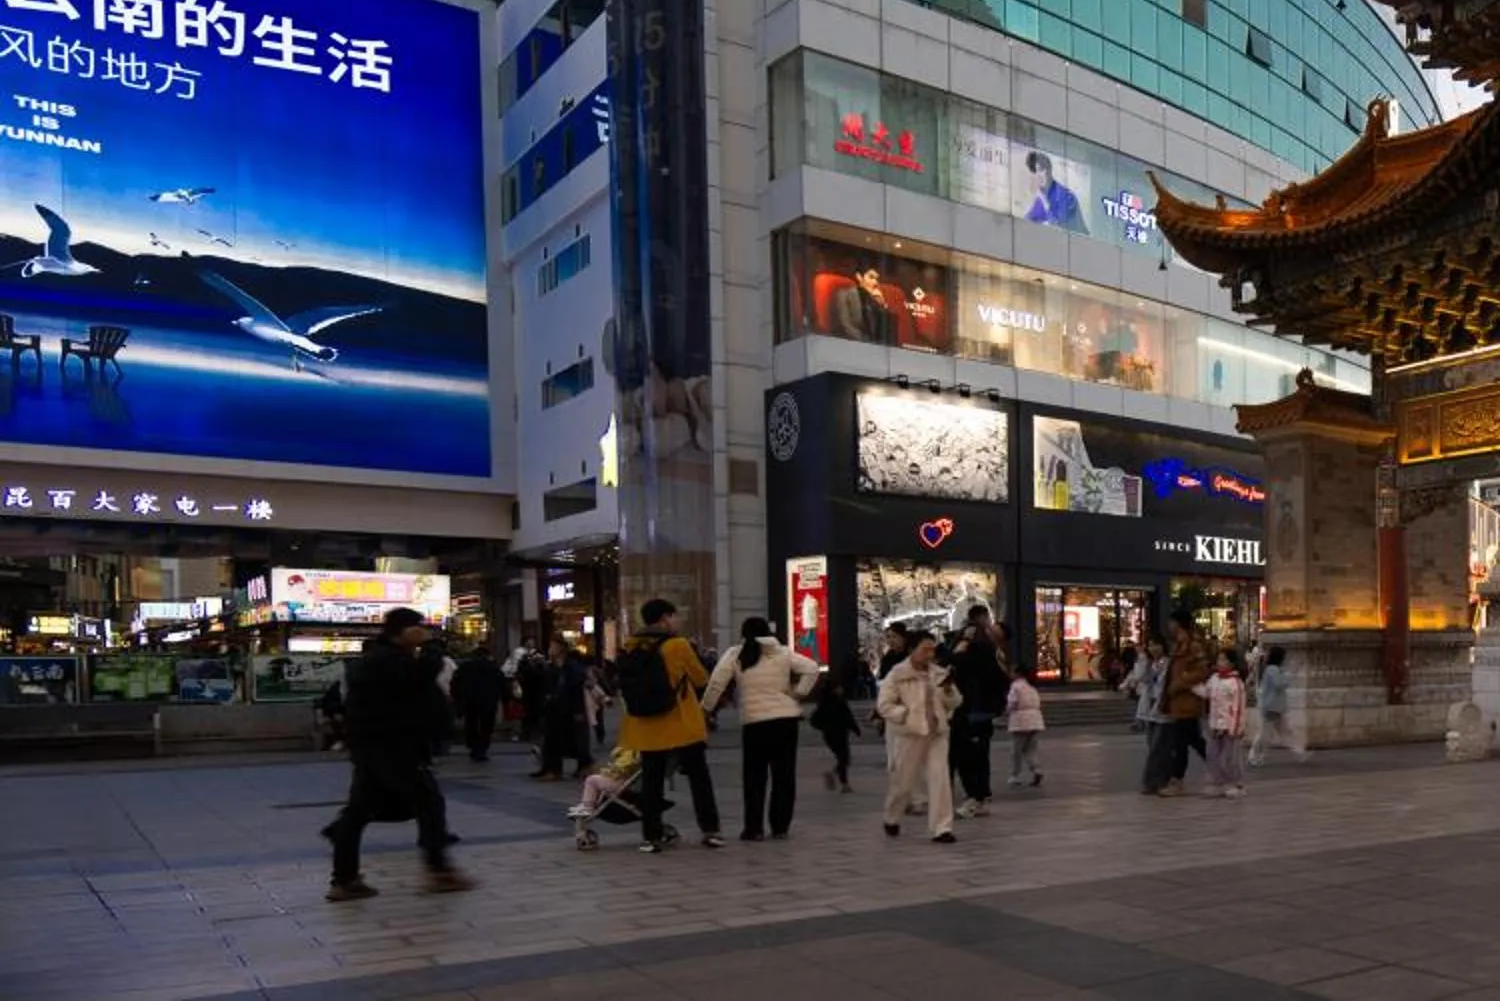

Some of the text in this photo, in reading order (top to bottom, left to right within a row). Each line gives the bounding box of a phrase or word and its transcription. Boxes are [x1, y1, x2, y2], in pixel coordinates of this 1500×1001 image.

[0, 26, 203, 100] 风的地方
[13, 94, 77, 117] THIS
[32, 114, 60, 130] IS
[1102, 198, 1157, 230] TISSOT
[976, 303, 1046, 333] VICUTU
[3, 486, 274, 521] 昆百大家电一楼
[1154, 534, 1267, 566] SINCE KIEHL
